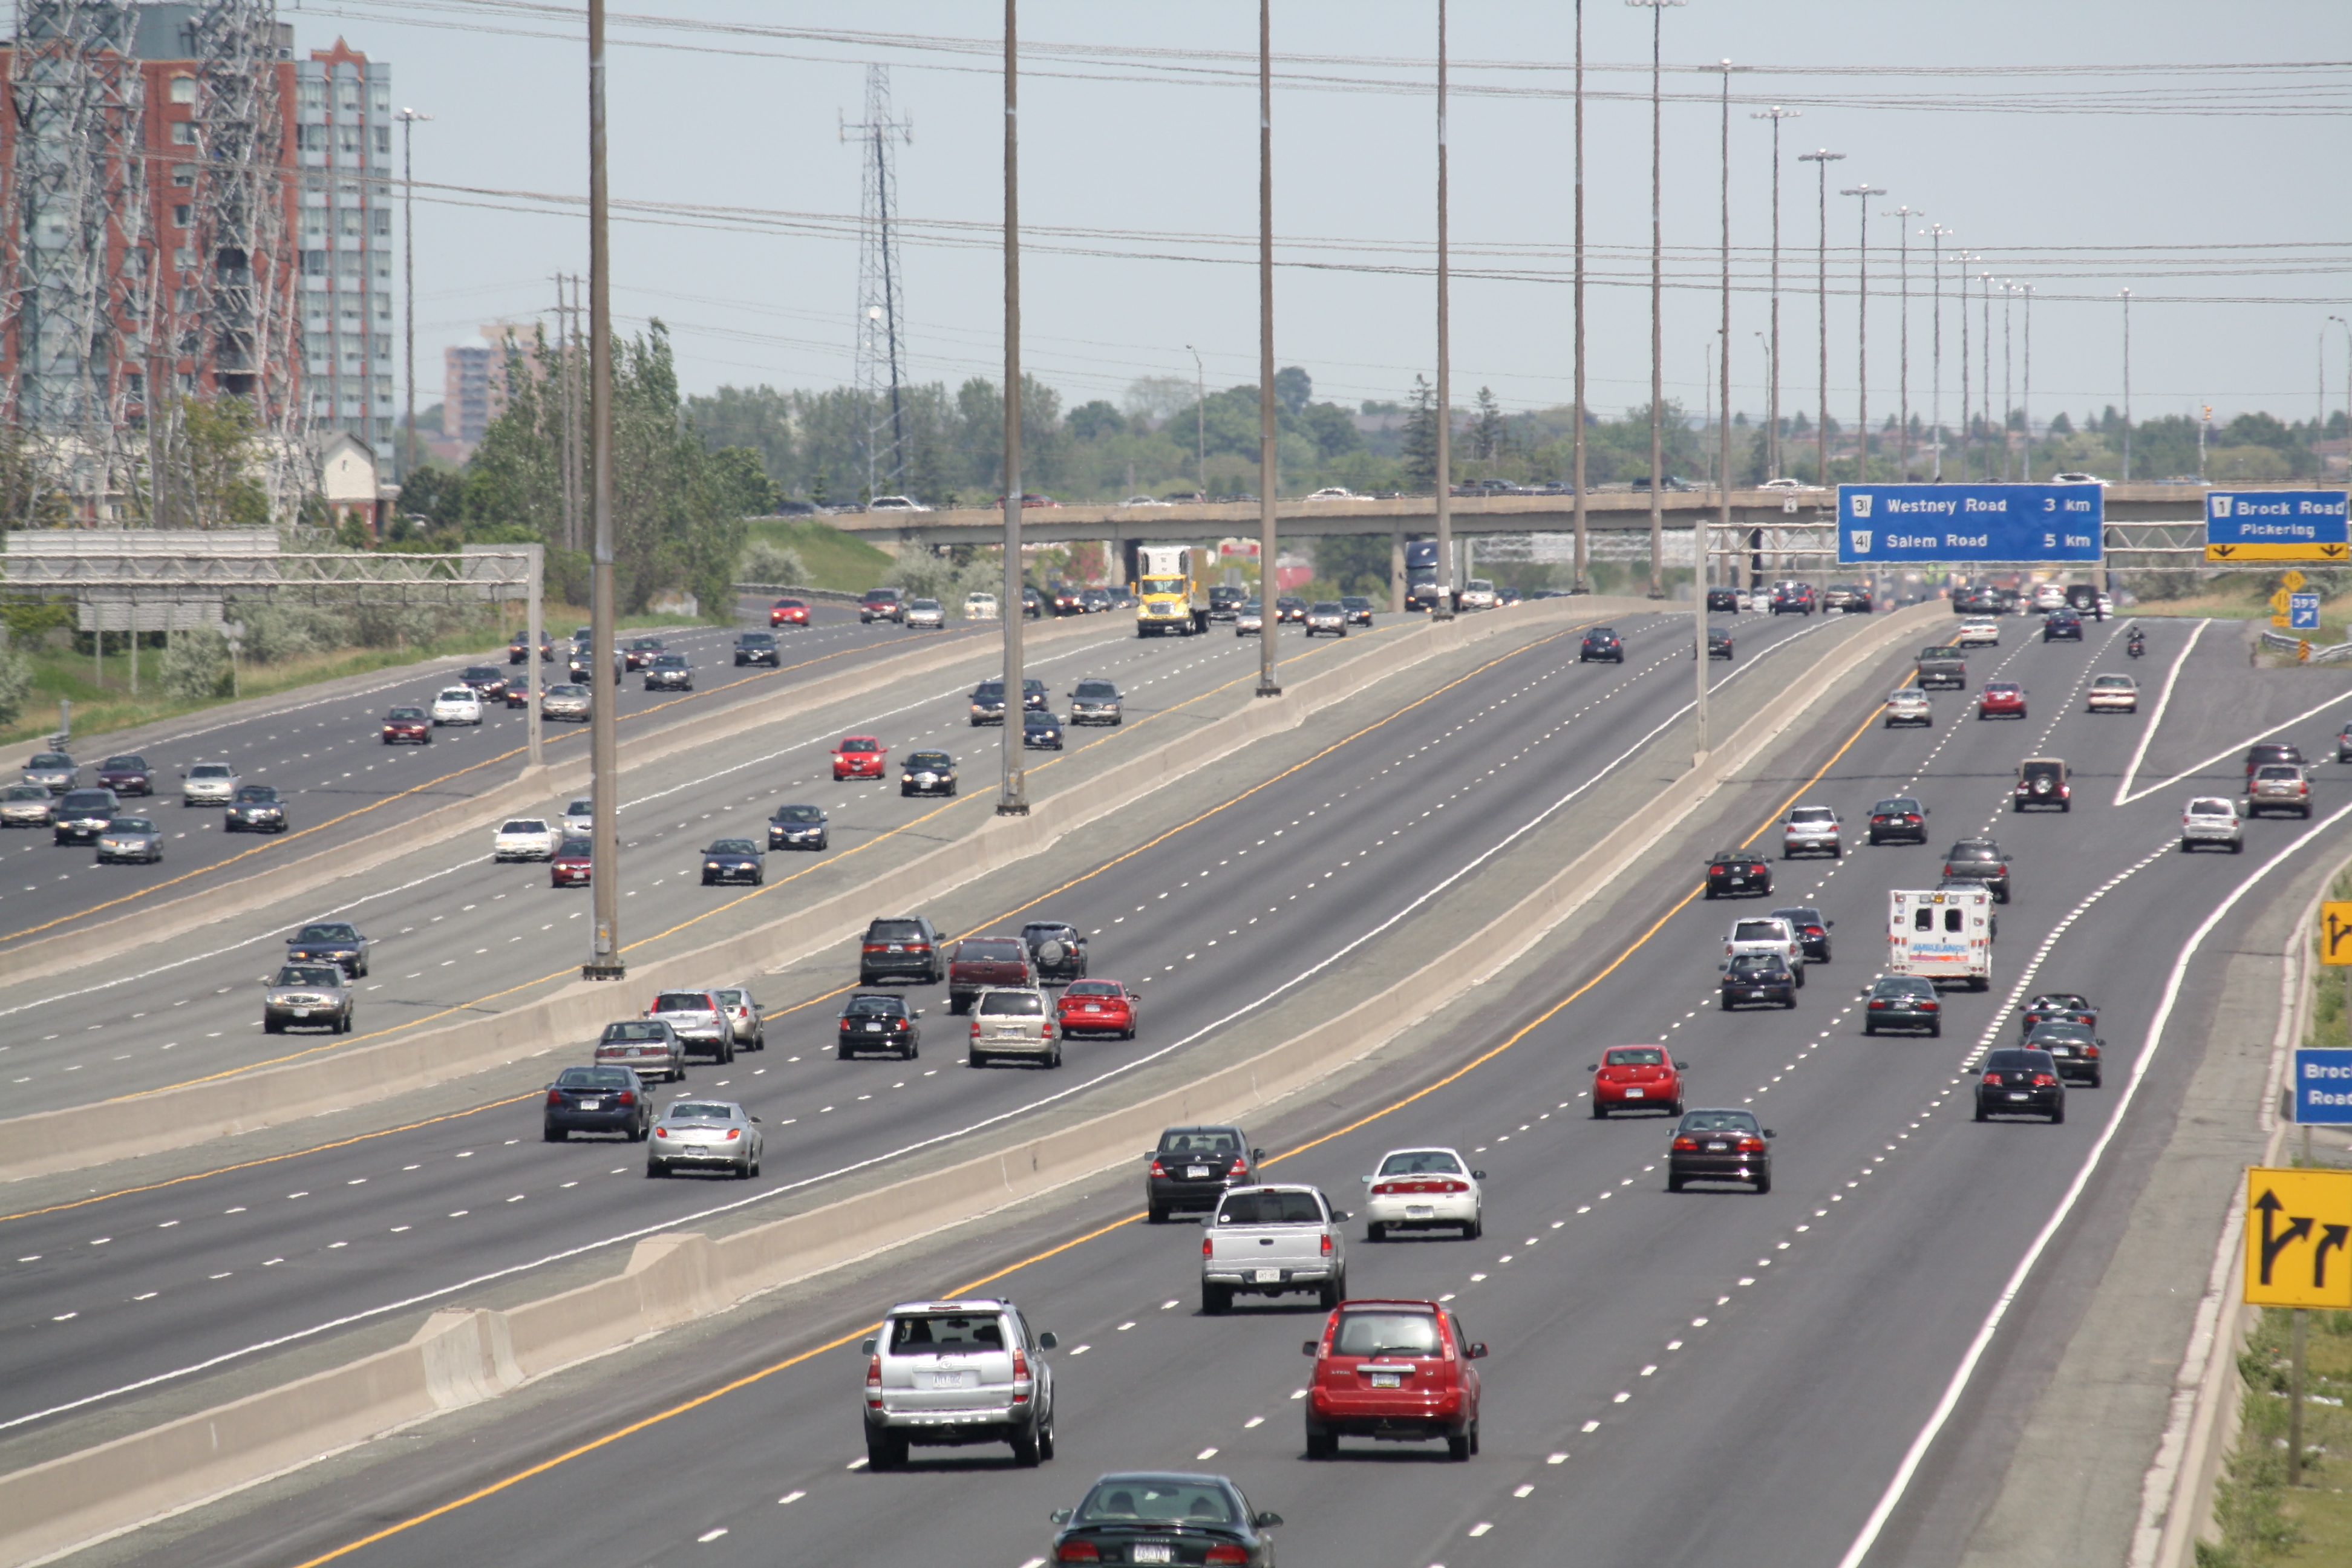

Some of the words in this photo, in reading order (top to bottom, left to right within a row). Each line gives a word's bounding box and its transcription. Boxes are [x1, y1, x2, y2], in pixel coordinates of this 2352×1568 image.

[1855, 499, 1868, 512] 31
[1887, 498, 1957, 515] Westney
[1965, 497, 2007, 512] Road
[2043, 498, 2056, 512] 3
[2065, 498, 2091, 512] km
[2237, 501, 2291, 515] Brock
[2299, 501, 2345, 515] Road
[2240, 524, 2316, 538] Pickering
[1855, 535, 1868, 547] 41
[1887, 534, 1937, 547] Salem
[1946, 534, 1988, 547] Road
[2043, 534, 2056, 547] 5
[2065, 534, 2091, 547] km
[2293, 598, 2318, 609] 399
[1913, 944, 1966, 952] AMBULANCE
[2304, 1063, 2352, 1079] Broc
